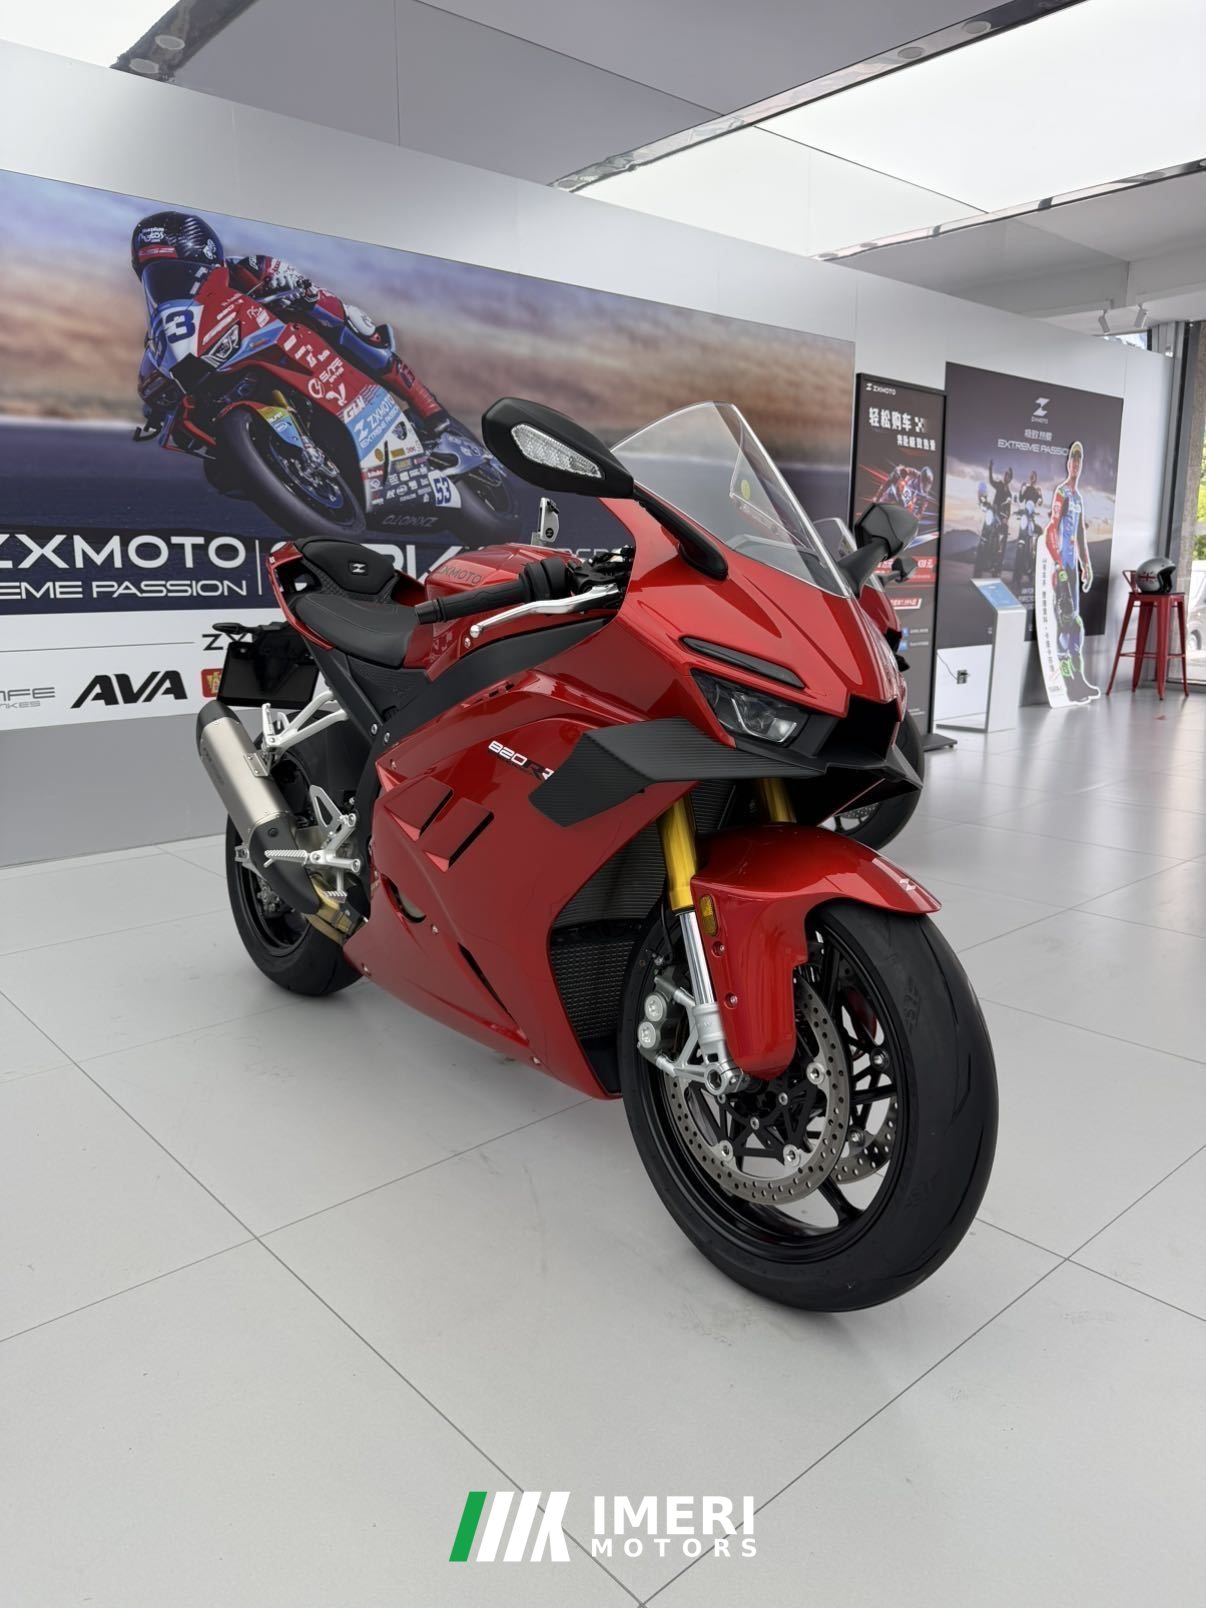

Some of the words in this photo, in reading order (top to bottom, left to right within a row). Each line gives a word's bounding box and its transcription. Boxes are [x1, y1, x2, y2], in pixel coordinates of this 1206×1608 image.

[998, 438, 1040, 453] EXTREME
[433, 476, 452, 505] 53
[92, 580, 247, 598] PASSION
[0, 687, 55, 701] FE
[70, 670, 188, 709] AVA
